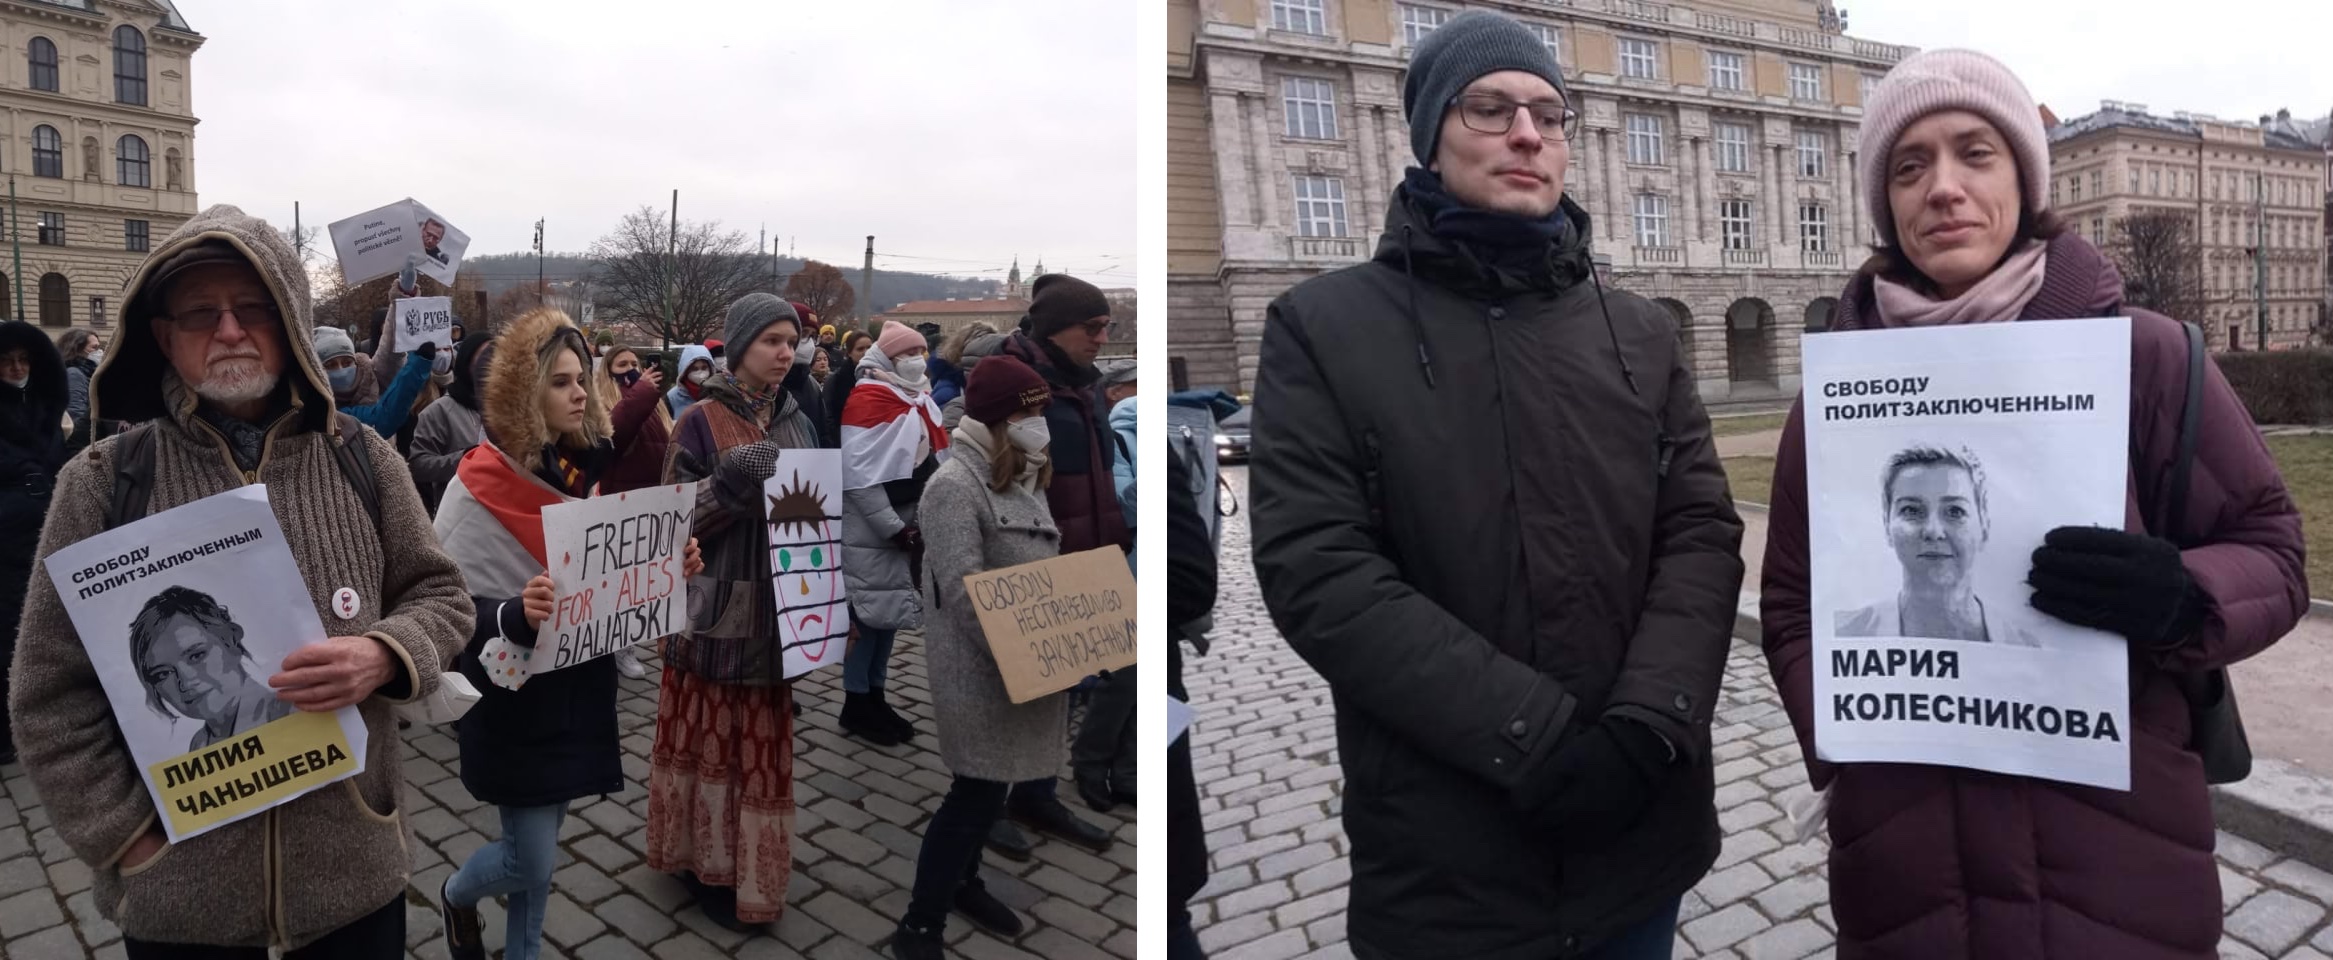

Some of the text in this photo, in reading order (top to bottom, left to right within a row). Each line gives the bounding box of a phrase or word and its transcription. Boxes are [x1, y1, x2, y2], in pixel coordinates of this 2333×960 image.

[357, 241, 383, 256] politické
[377, 226, 401, 238] všechny
[423, 310, 450, 326] РУСЬ
[1823, 376, 1930, 397] СВОБОДУ
[1824, 394, 2095, 421] ПОЛИТЗАКЛЮЧЕННЫМ
[72, 546, 150, 584] СВОБОДУ
[78, 527, 263, 600] ПОЛИТЗАКЛЮЧЕННЫМ
[581, 507, 694, 581] FREEDOM
[554, 556, 674, 632] FOR ALES
[974, 566, 1054, 612] СВОБОДУ
[554, 596, 671, 669] BIALIATSKI
[1012, 589, 1122, 636] НЕСПРАВЕДЛИВО
[1831, 649, 1959, 679] МАРИЯ
[1833, 693, 2121, 742] КОЛЕСНИКОВА
[163, 734, 265, 788] ЛИЛИЯ
[176, 743, 347, 816] ЧАНЫШЕВА
